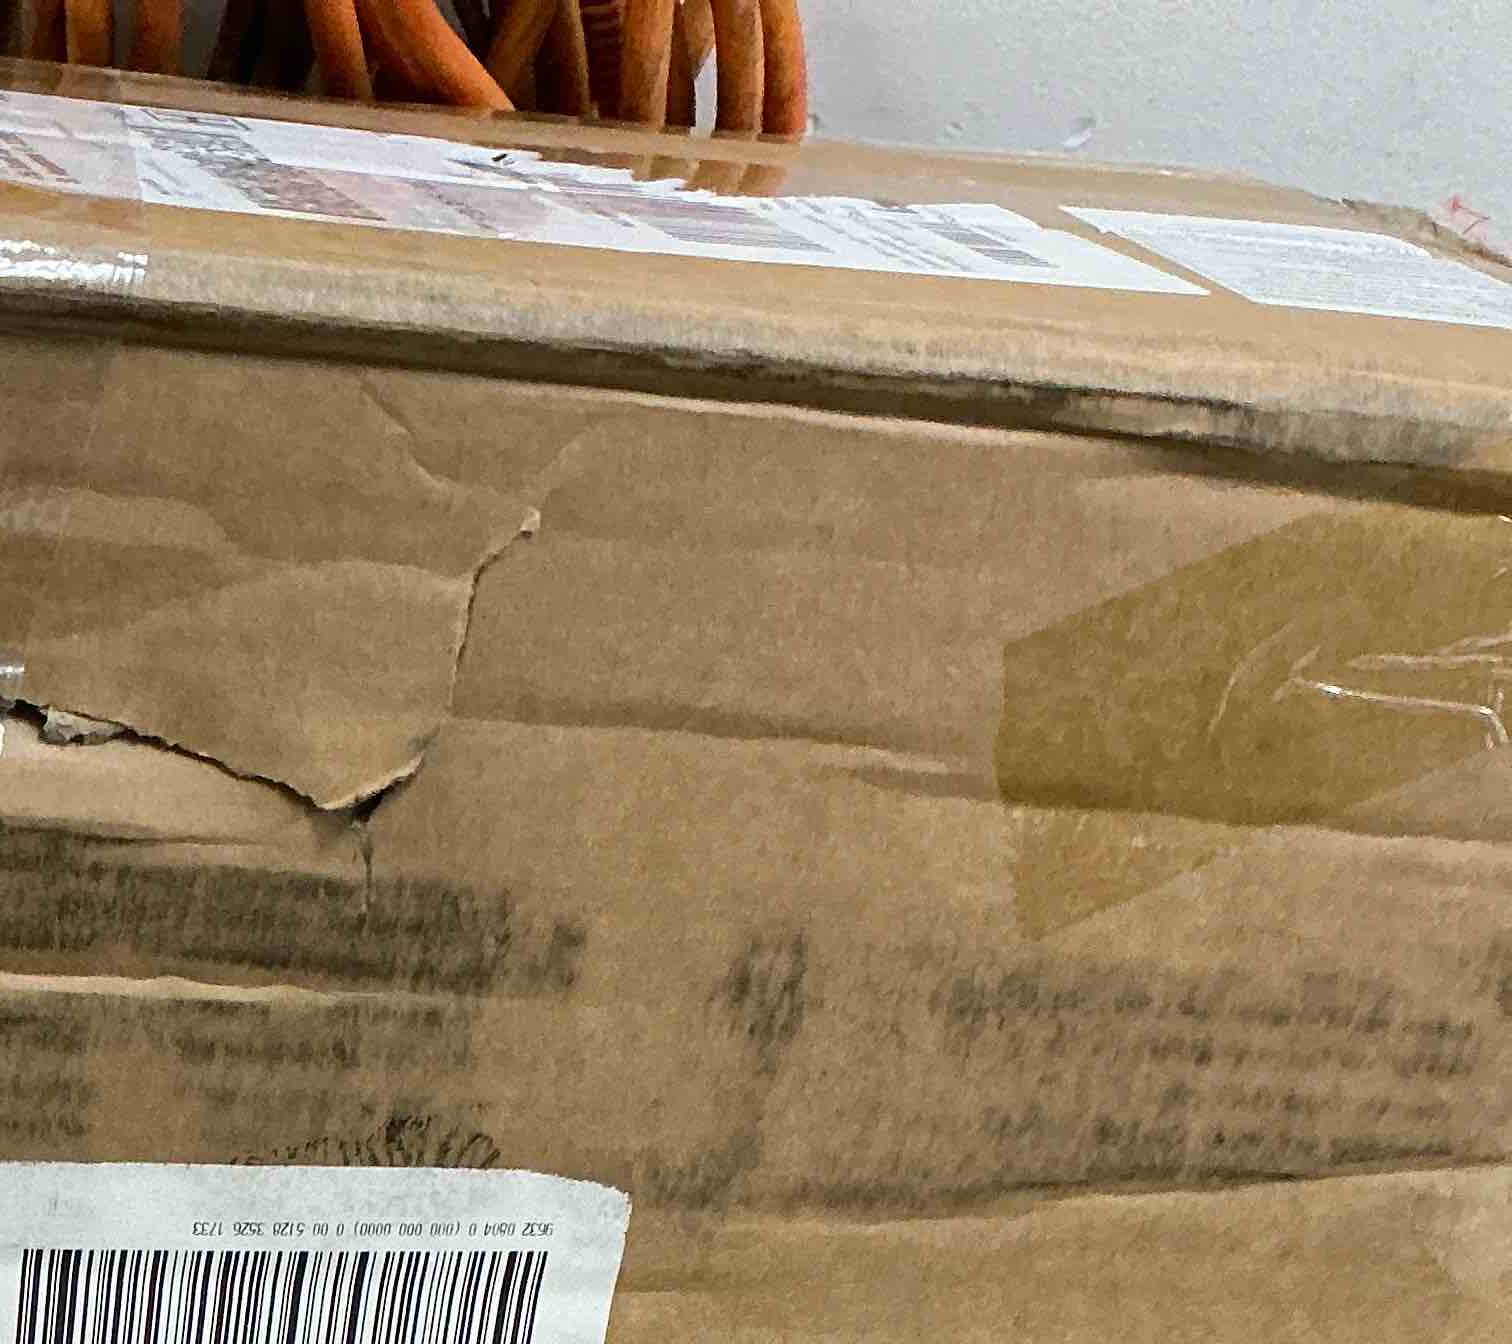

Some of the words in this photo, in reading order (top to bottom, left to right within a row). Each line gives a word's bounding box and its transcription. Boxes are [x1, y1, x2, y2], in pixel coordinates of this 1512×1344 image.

[191, 1221, 223, 1237] 1733
[233, 1221, 265, 1237] 3526
[312, 1221, 329, 1237] 00
